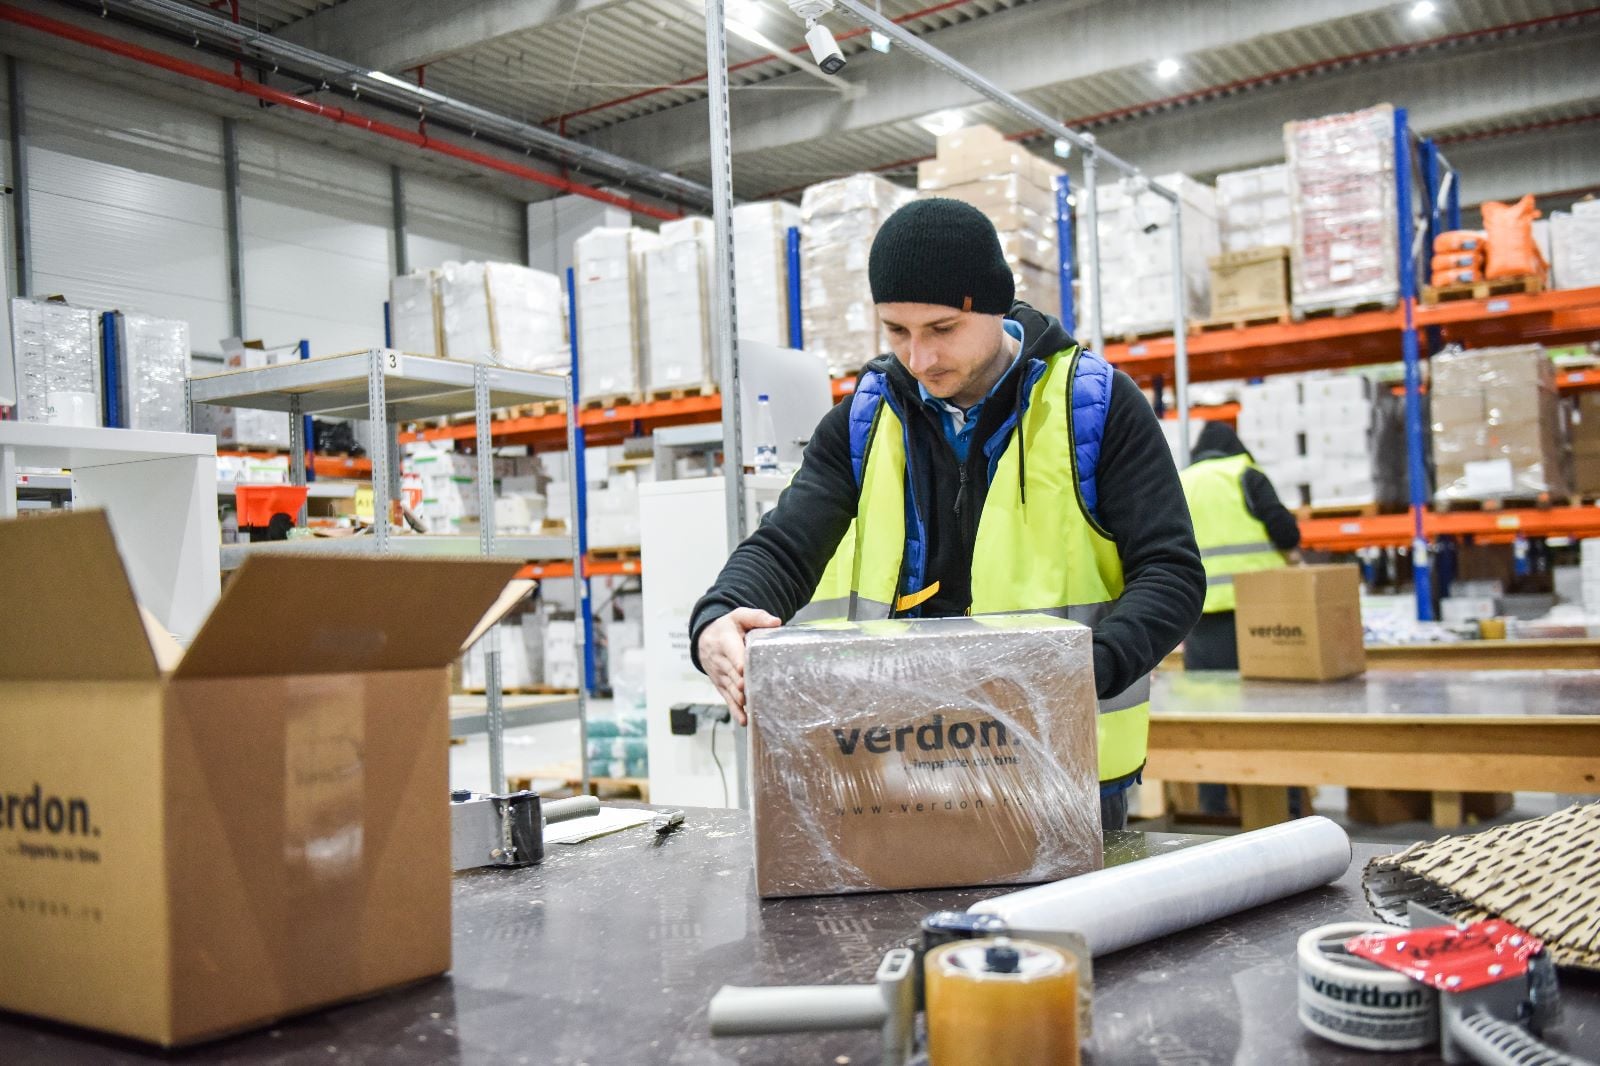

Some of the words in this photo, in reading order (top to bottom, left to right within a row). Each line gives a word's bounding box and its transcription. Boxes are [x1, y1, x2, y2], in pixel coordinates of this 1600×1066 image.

[389, 353, 397, 369] 3
[1249, 623, 1306, 638] verdon.
[833, 714, 1021, 756] verdon.
